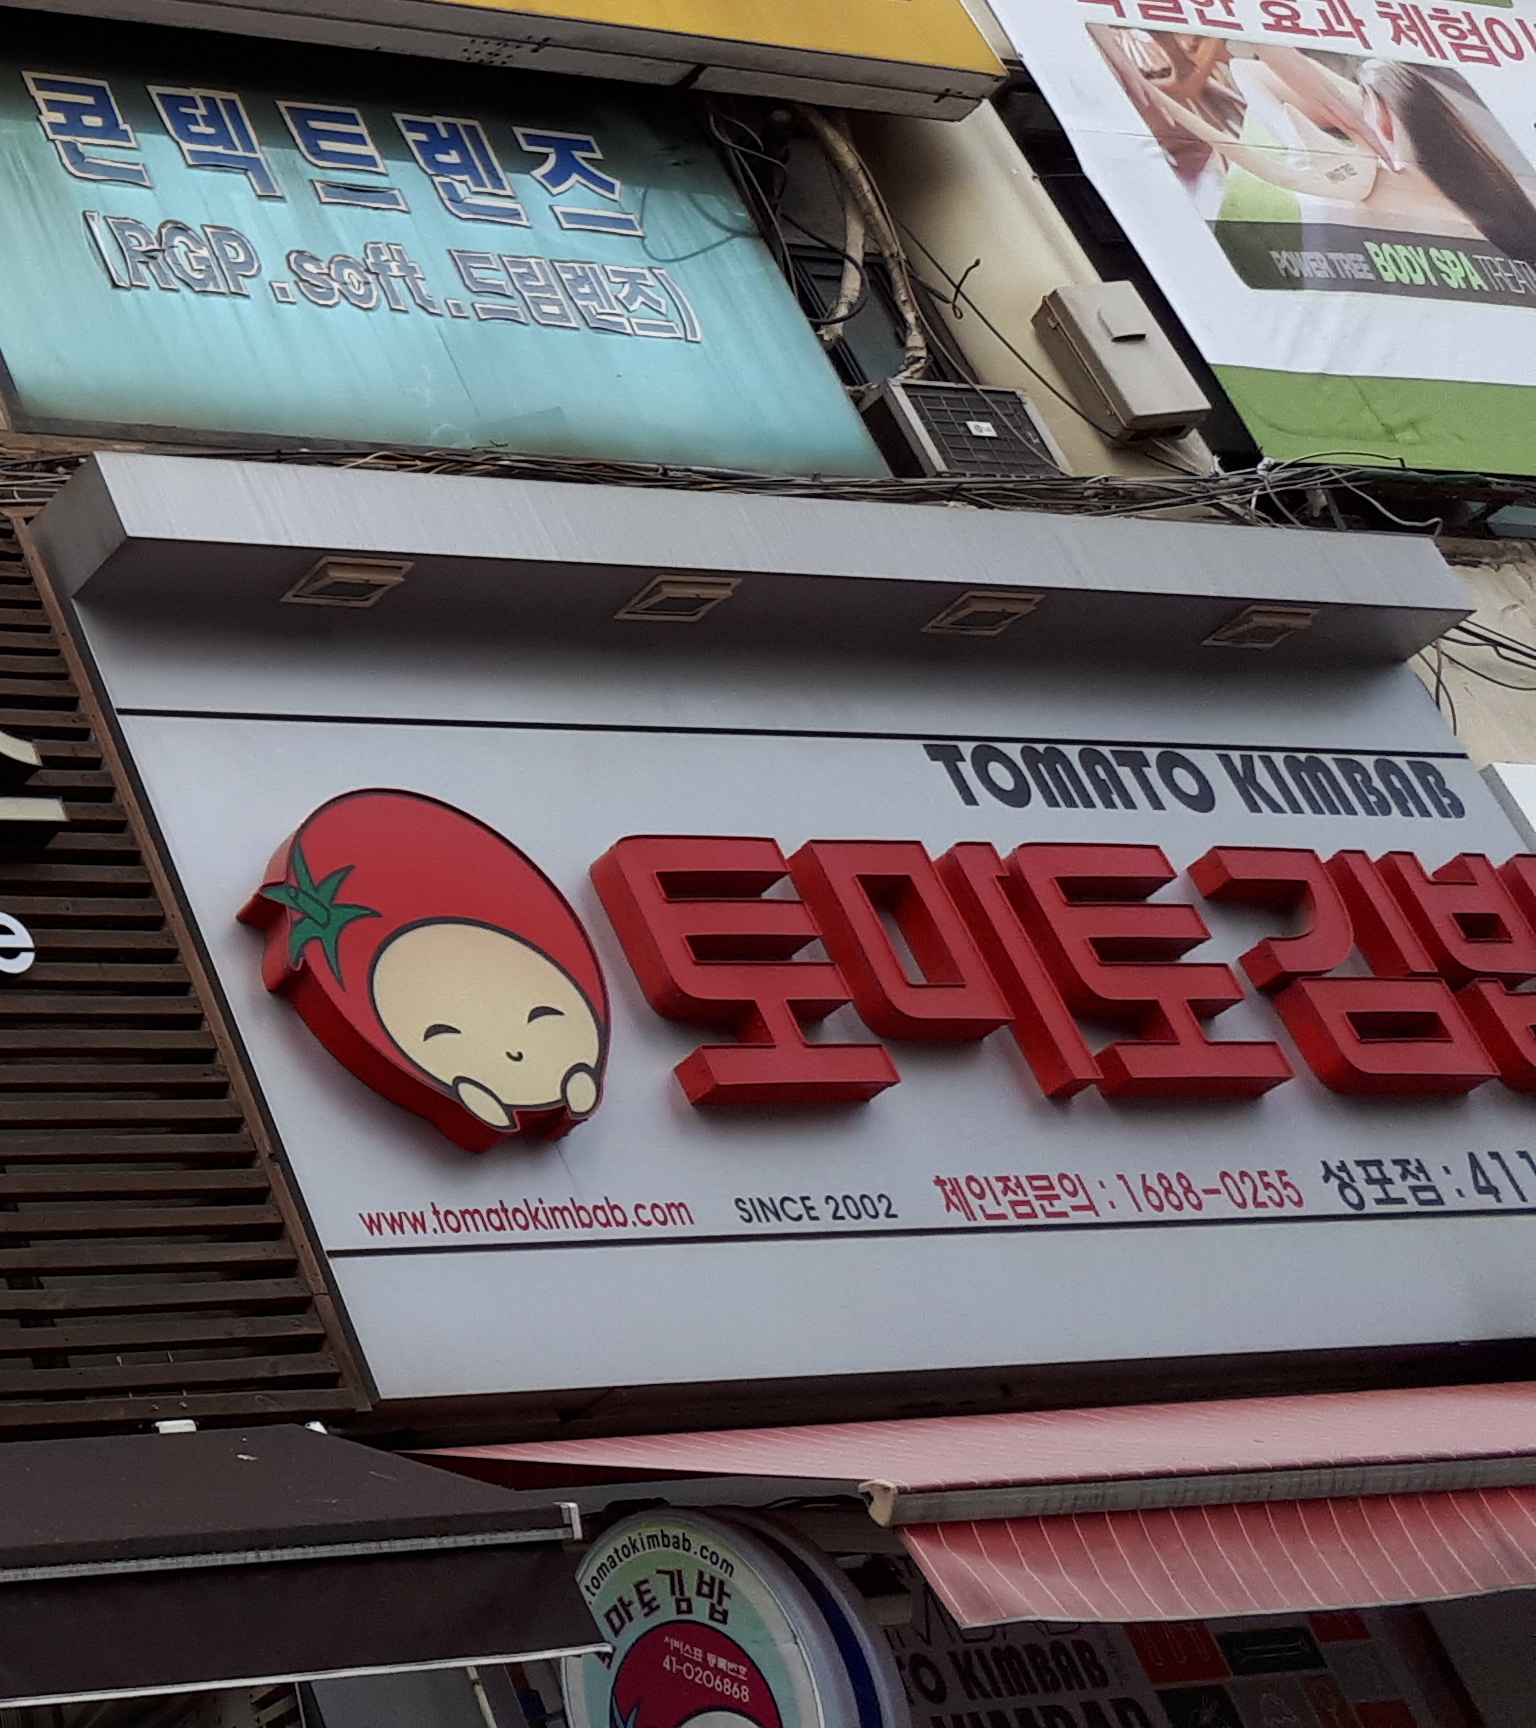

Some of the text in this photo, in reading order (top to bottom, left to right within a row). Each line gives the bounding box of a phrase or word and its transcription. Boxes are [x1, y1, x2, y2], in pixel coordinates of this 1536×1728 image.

[20, 70, 647, 239] 콘텍트렌즈
[1363, 240, 1439, 287] BODY
[1428, 246, 1490, 292] SPA
[926, 742, 1466, 820] TOMATO KIMBAB
[359, 1197, 696, 1237] www.tomatokimbab.com
[733, 1192, 898, 1224] SINCE 2002
[1118, 1168, 1306, 1215] 1688-0255
[661, 1653, 752, 1704] 41-0206868
